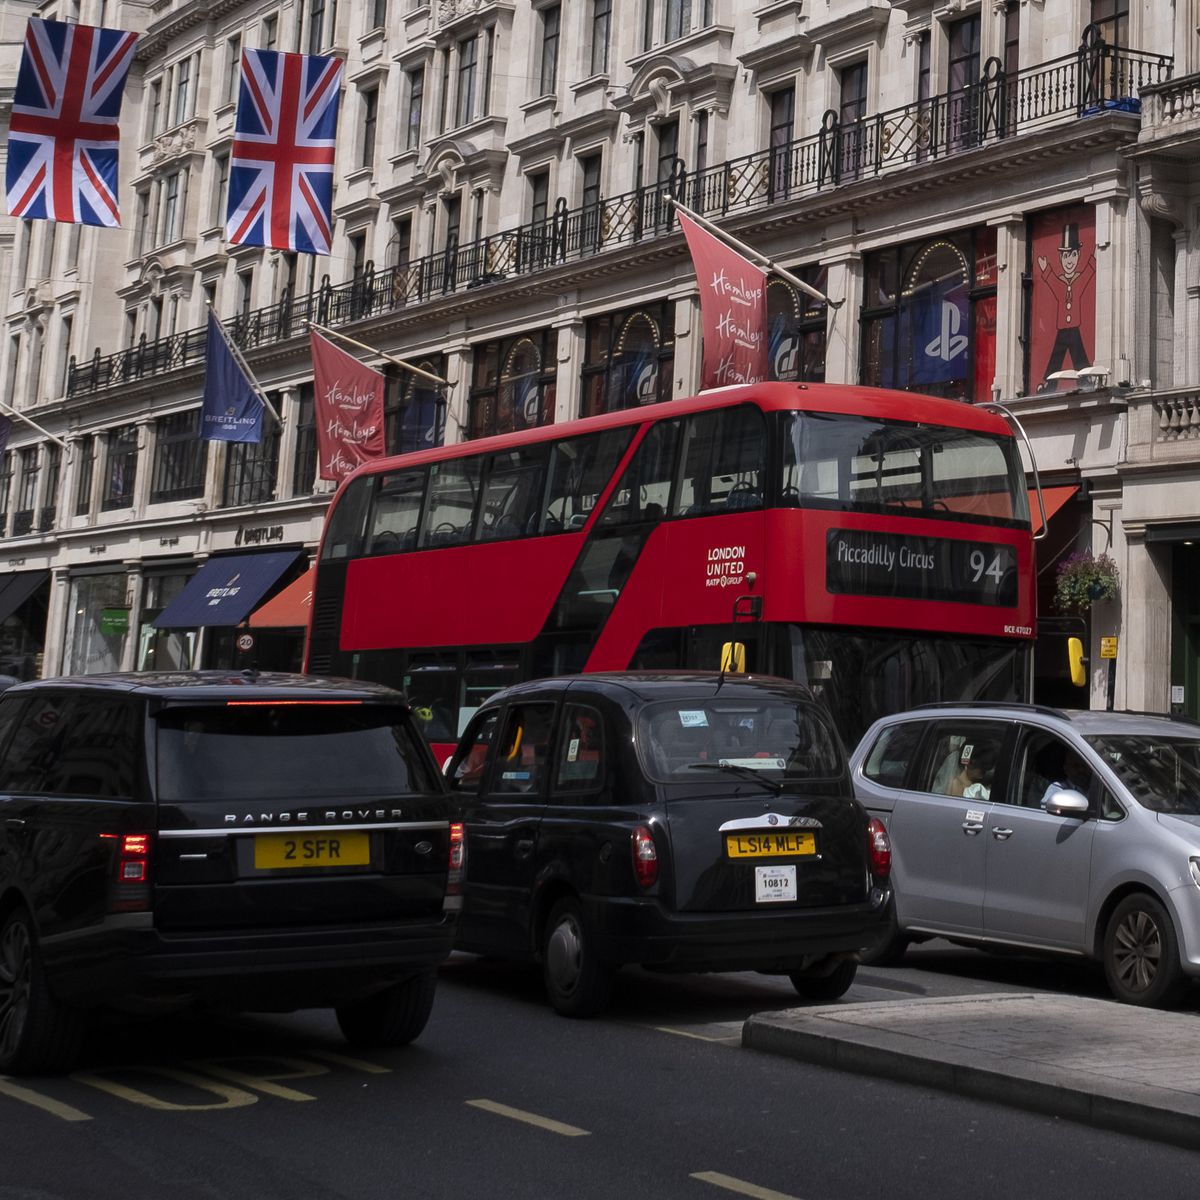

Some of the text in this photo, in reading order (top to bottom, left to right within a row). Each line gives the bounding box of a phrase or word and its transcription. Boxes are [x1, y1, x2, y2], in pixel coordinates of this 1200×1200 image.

[710, 268, 763, 309] Hamleys
[715, 309, 764, 351] Hamleys
[324, 379, 376, 411] Hamleys
[204, 414, 257, 425] BREITLING
[326, 415, 377, 444] Hamleys
[326, 448, 363, 474] Haml
[708, 546, 745, 561] LONDON
[838, 541, 935, 572] Piccadilly Circus
[707, 561, 744, 576] UNITED
[970, 550, 1005, 584] 94
[241, 638, 251, 646] 20
[224, 809, 402, 823] RANGE ROVER
[284, 840, 341, 860] 2 SFR
[737, 836, 771, 854] LS14
